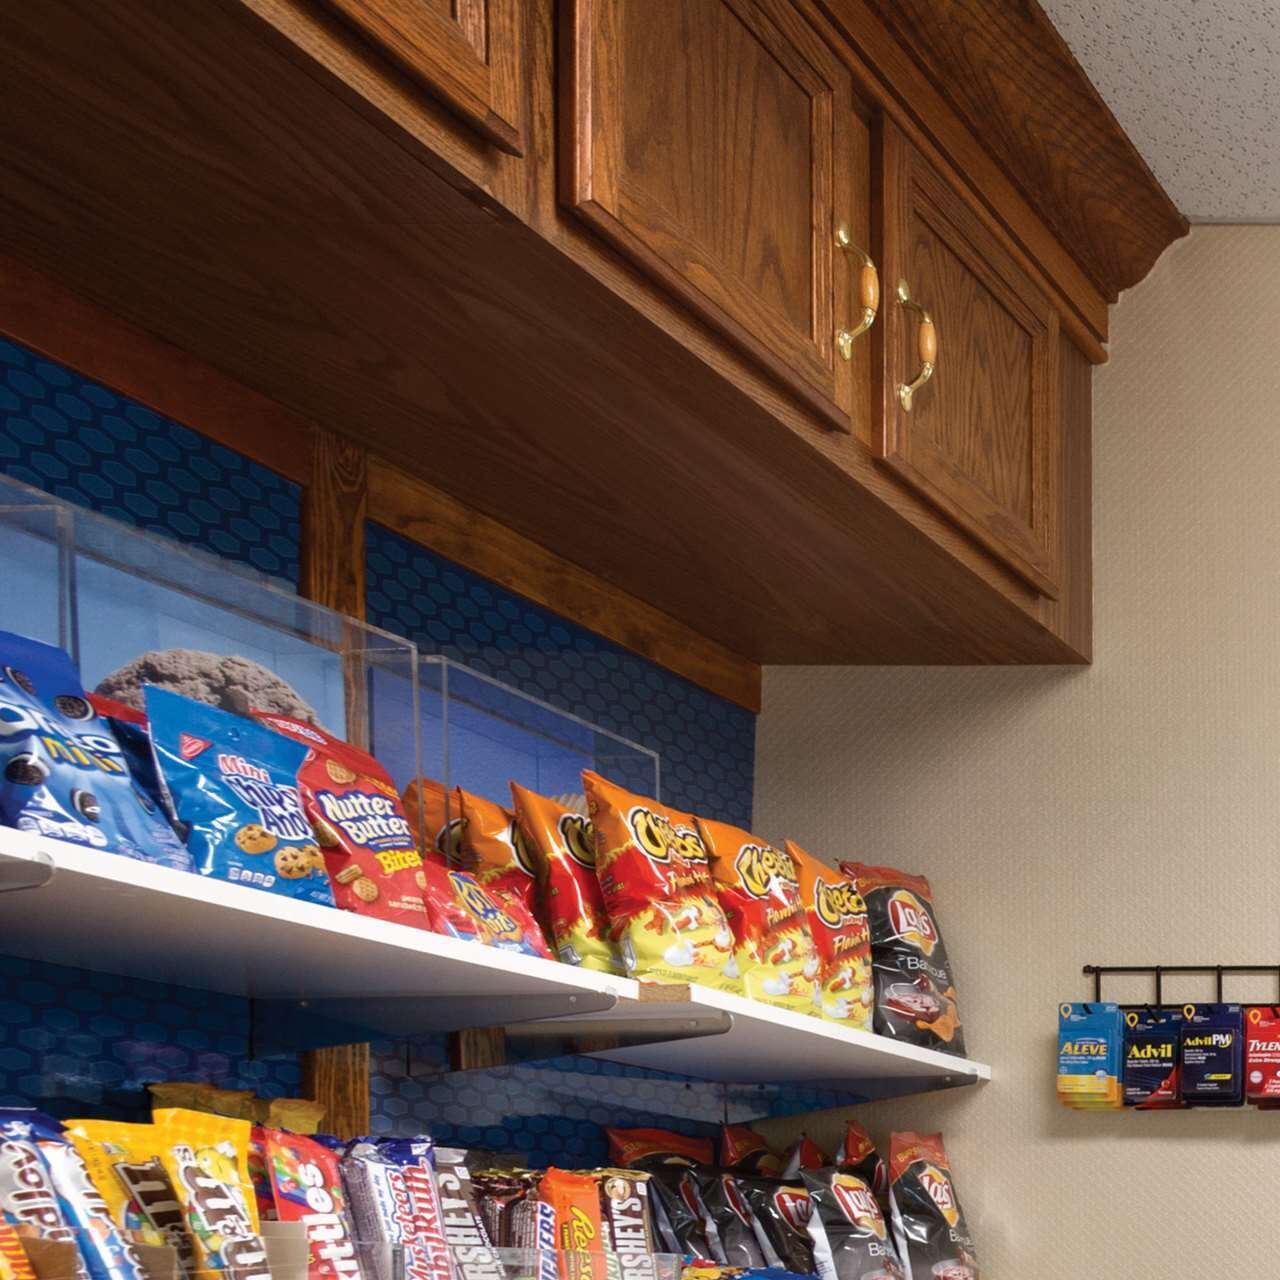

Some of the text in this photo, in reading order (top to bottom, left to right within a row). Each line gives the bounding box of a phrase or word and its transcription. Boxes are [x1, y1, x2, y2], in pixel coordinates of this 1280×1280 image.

[218, 754, 273, 785] Mini
[319, 793, 394, 822] Nutter
[340, 817, 410, 845] Butter
[1060, 1041, 1108, 1057] ALEVE
[1183, 1033, 1231, 1047] Advil PM
[1127, 1044, 1174, 1059] Advil
